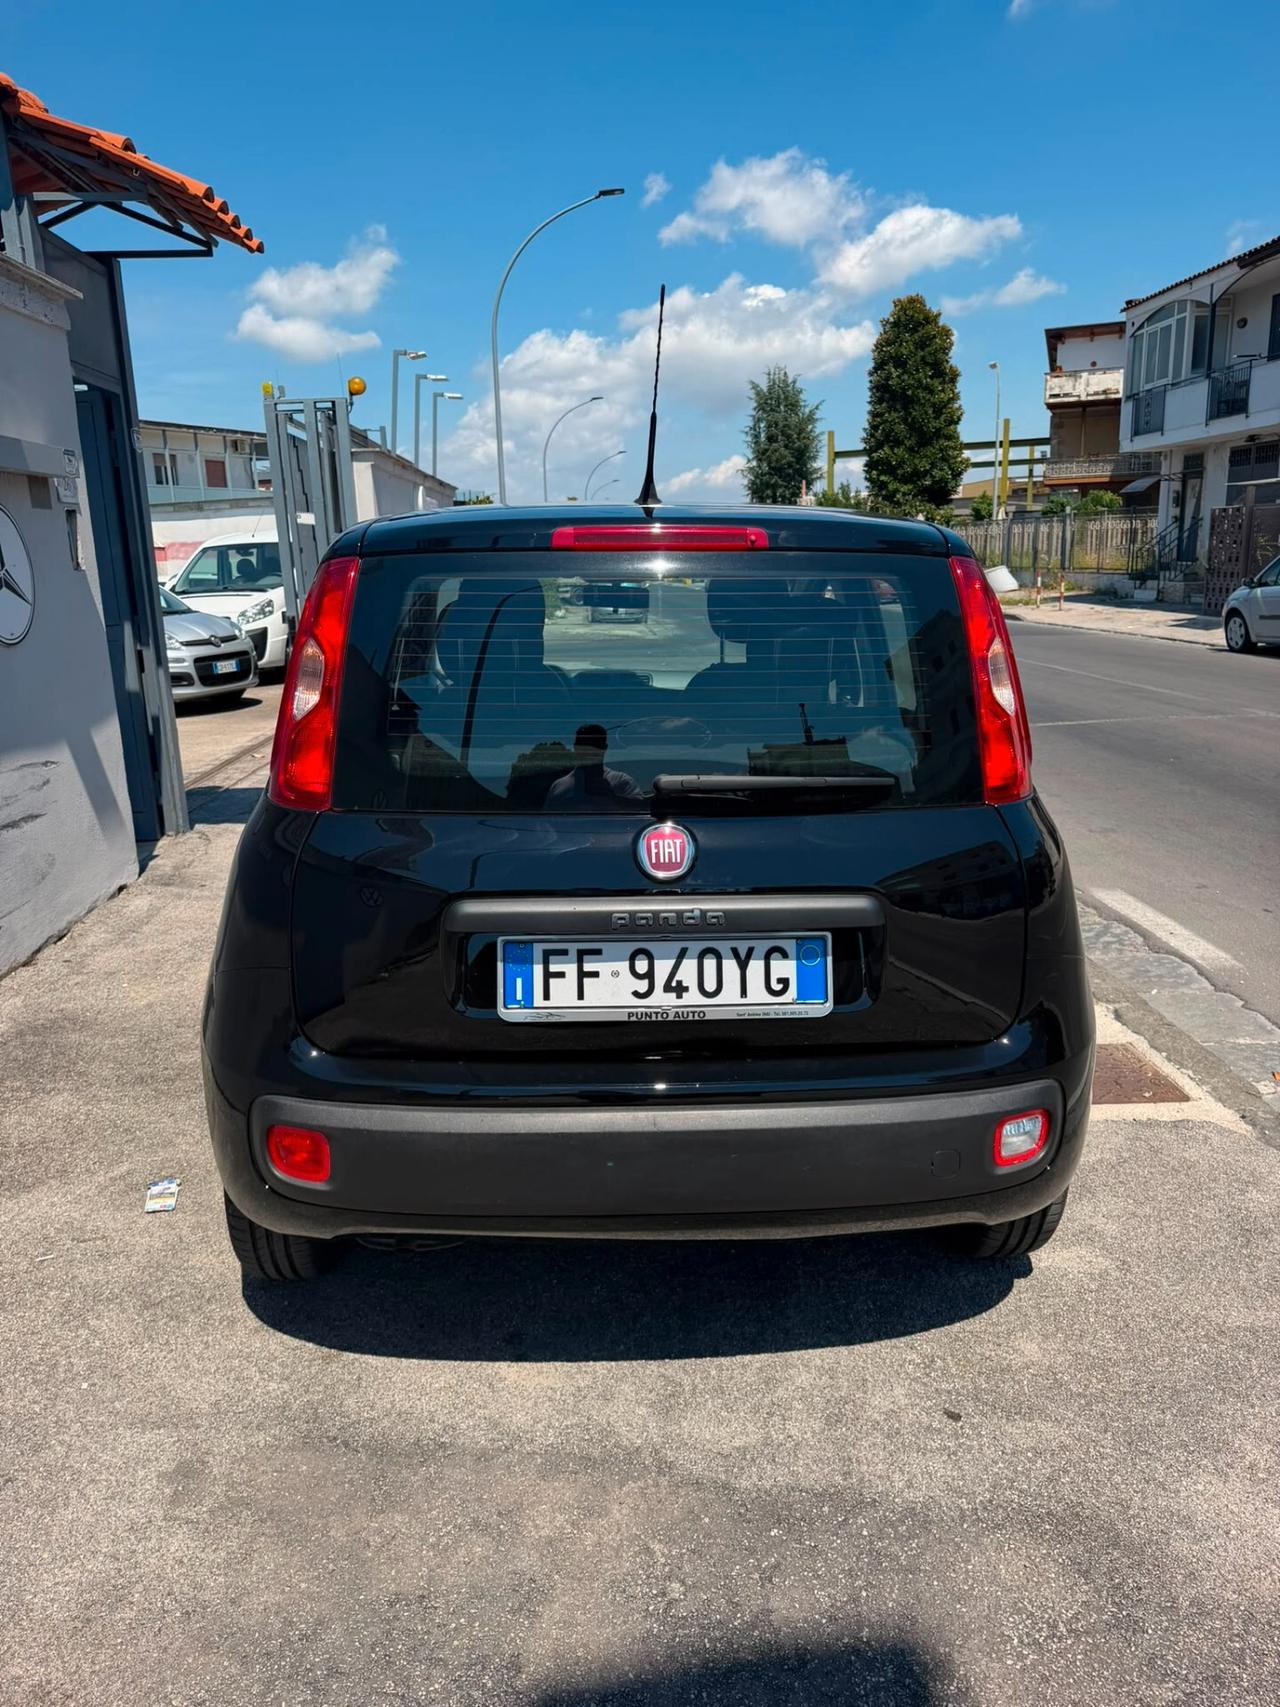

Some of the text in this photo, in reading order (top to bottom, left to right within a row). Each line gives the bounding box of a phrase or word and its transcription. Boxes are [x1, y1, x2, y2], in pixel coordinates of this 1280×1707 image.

[650, 839, 683, 863] FIAT
[611, 908, 726, 930] panda
[542, 945, 790, 1001] FF 940YG
[627, 1010, 706, 1020] PUNTO AUTO
